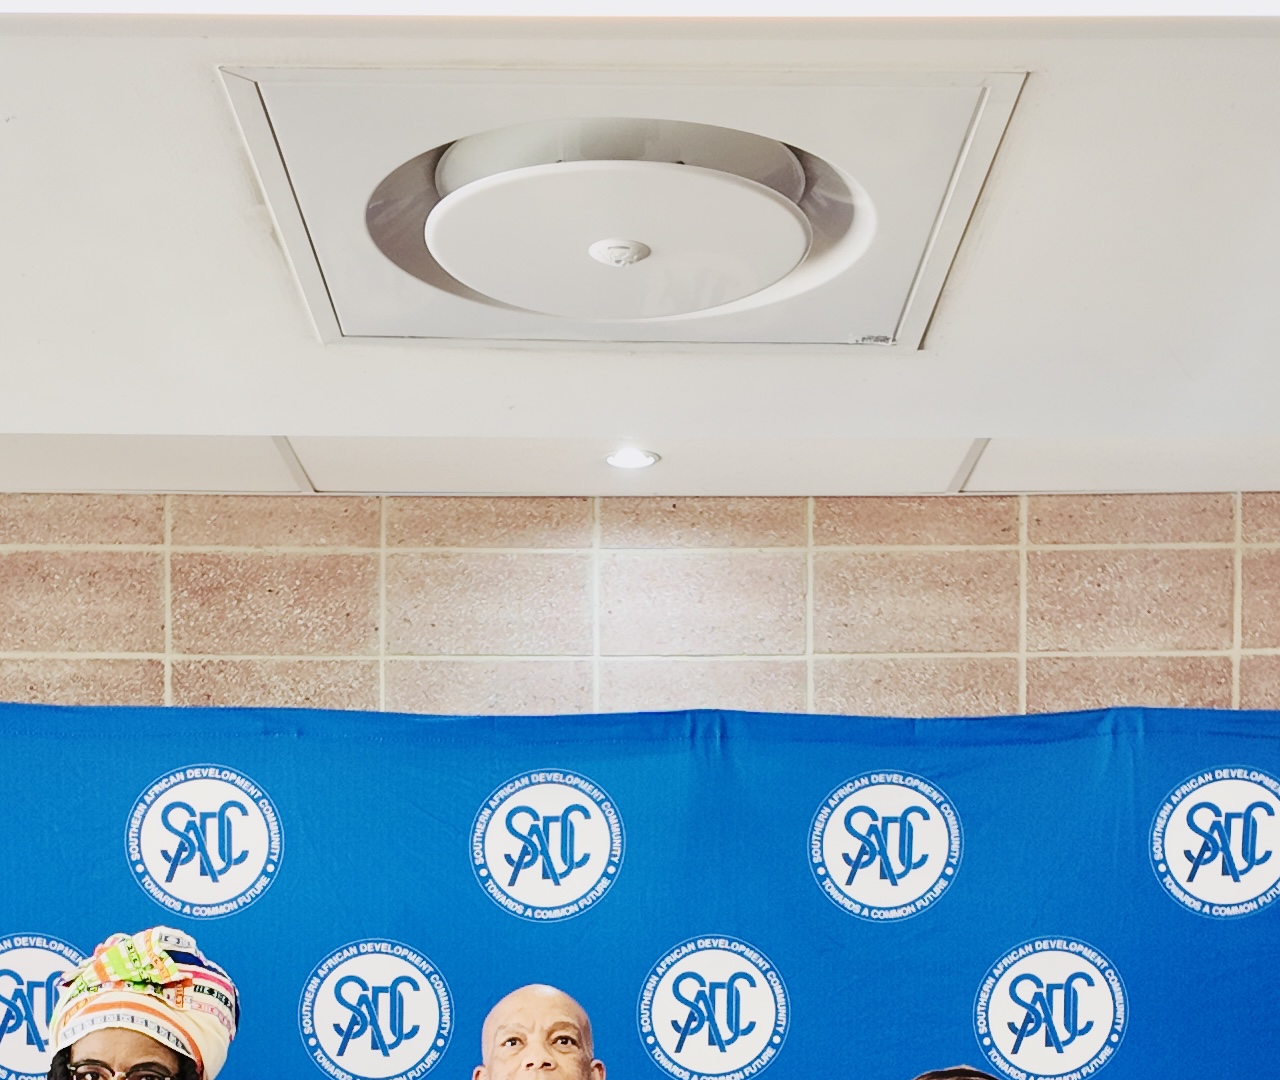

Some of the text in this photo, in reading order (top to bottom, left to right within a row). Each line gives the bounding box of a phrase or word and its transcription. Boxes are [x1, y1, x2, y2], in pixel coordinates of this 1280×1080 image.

[128, 768, 281, 862] SOUTHERN AFRICAN DEVELOPMENT COMMUNITY
[472, 772, 622, 866] SOUTHERN AFRICAN DEVELOPMENT COMMUNITY
[811, 773, 961, 866] SOUTHERN AFRICAN DEVELOPMENT COMMUNITY
[1152, 802, 1174, 861] SOUTHERN
[1170, 772, 1214, 805] AFRICAN
[141, 874, 183, 911] TOWARDS
[191, 900, 239, 916] COMMON
[237, 874, 271, 907] FUTURE
[484, 878, 525, 915] TOWARDS
[533, 903, 580, 920] COMMON
[578, 876, 611, 909] FUTURE
[822, 877, 862, 914] TOWARDS
[870, 904, 917, 919] COMMON
[915, 878, 949, 910] FUTURE
[1162, 874, 1203, 911] TOWARDS
[1211, 900, 1259, 917] COMMON
[301, 942, 451, 1037] SOUTHERN AFRICAN DEVELOPMENT COMMUNITY
[640, 939, 787, 1033] SOUTHERN AFRICAN DEVELOPMENT COMMUNITY
[976, 939, 1125, 1034] SOUTHERN AFRICAN DEVELOPMENT COMMUNITY
[407, 1049, 440, 1080] FUTURE
[744, 1045, 776, 1077] FUTURE
[1081, 1044, 1114, 1077] FUTURE
